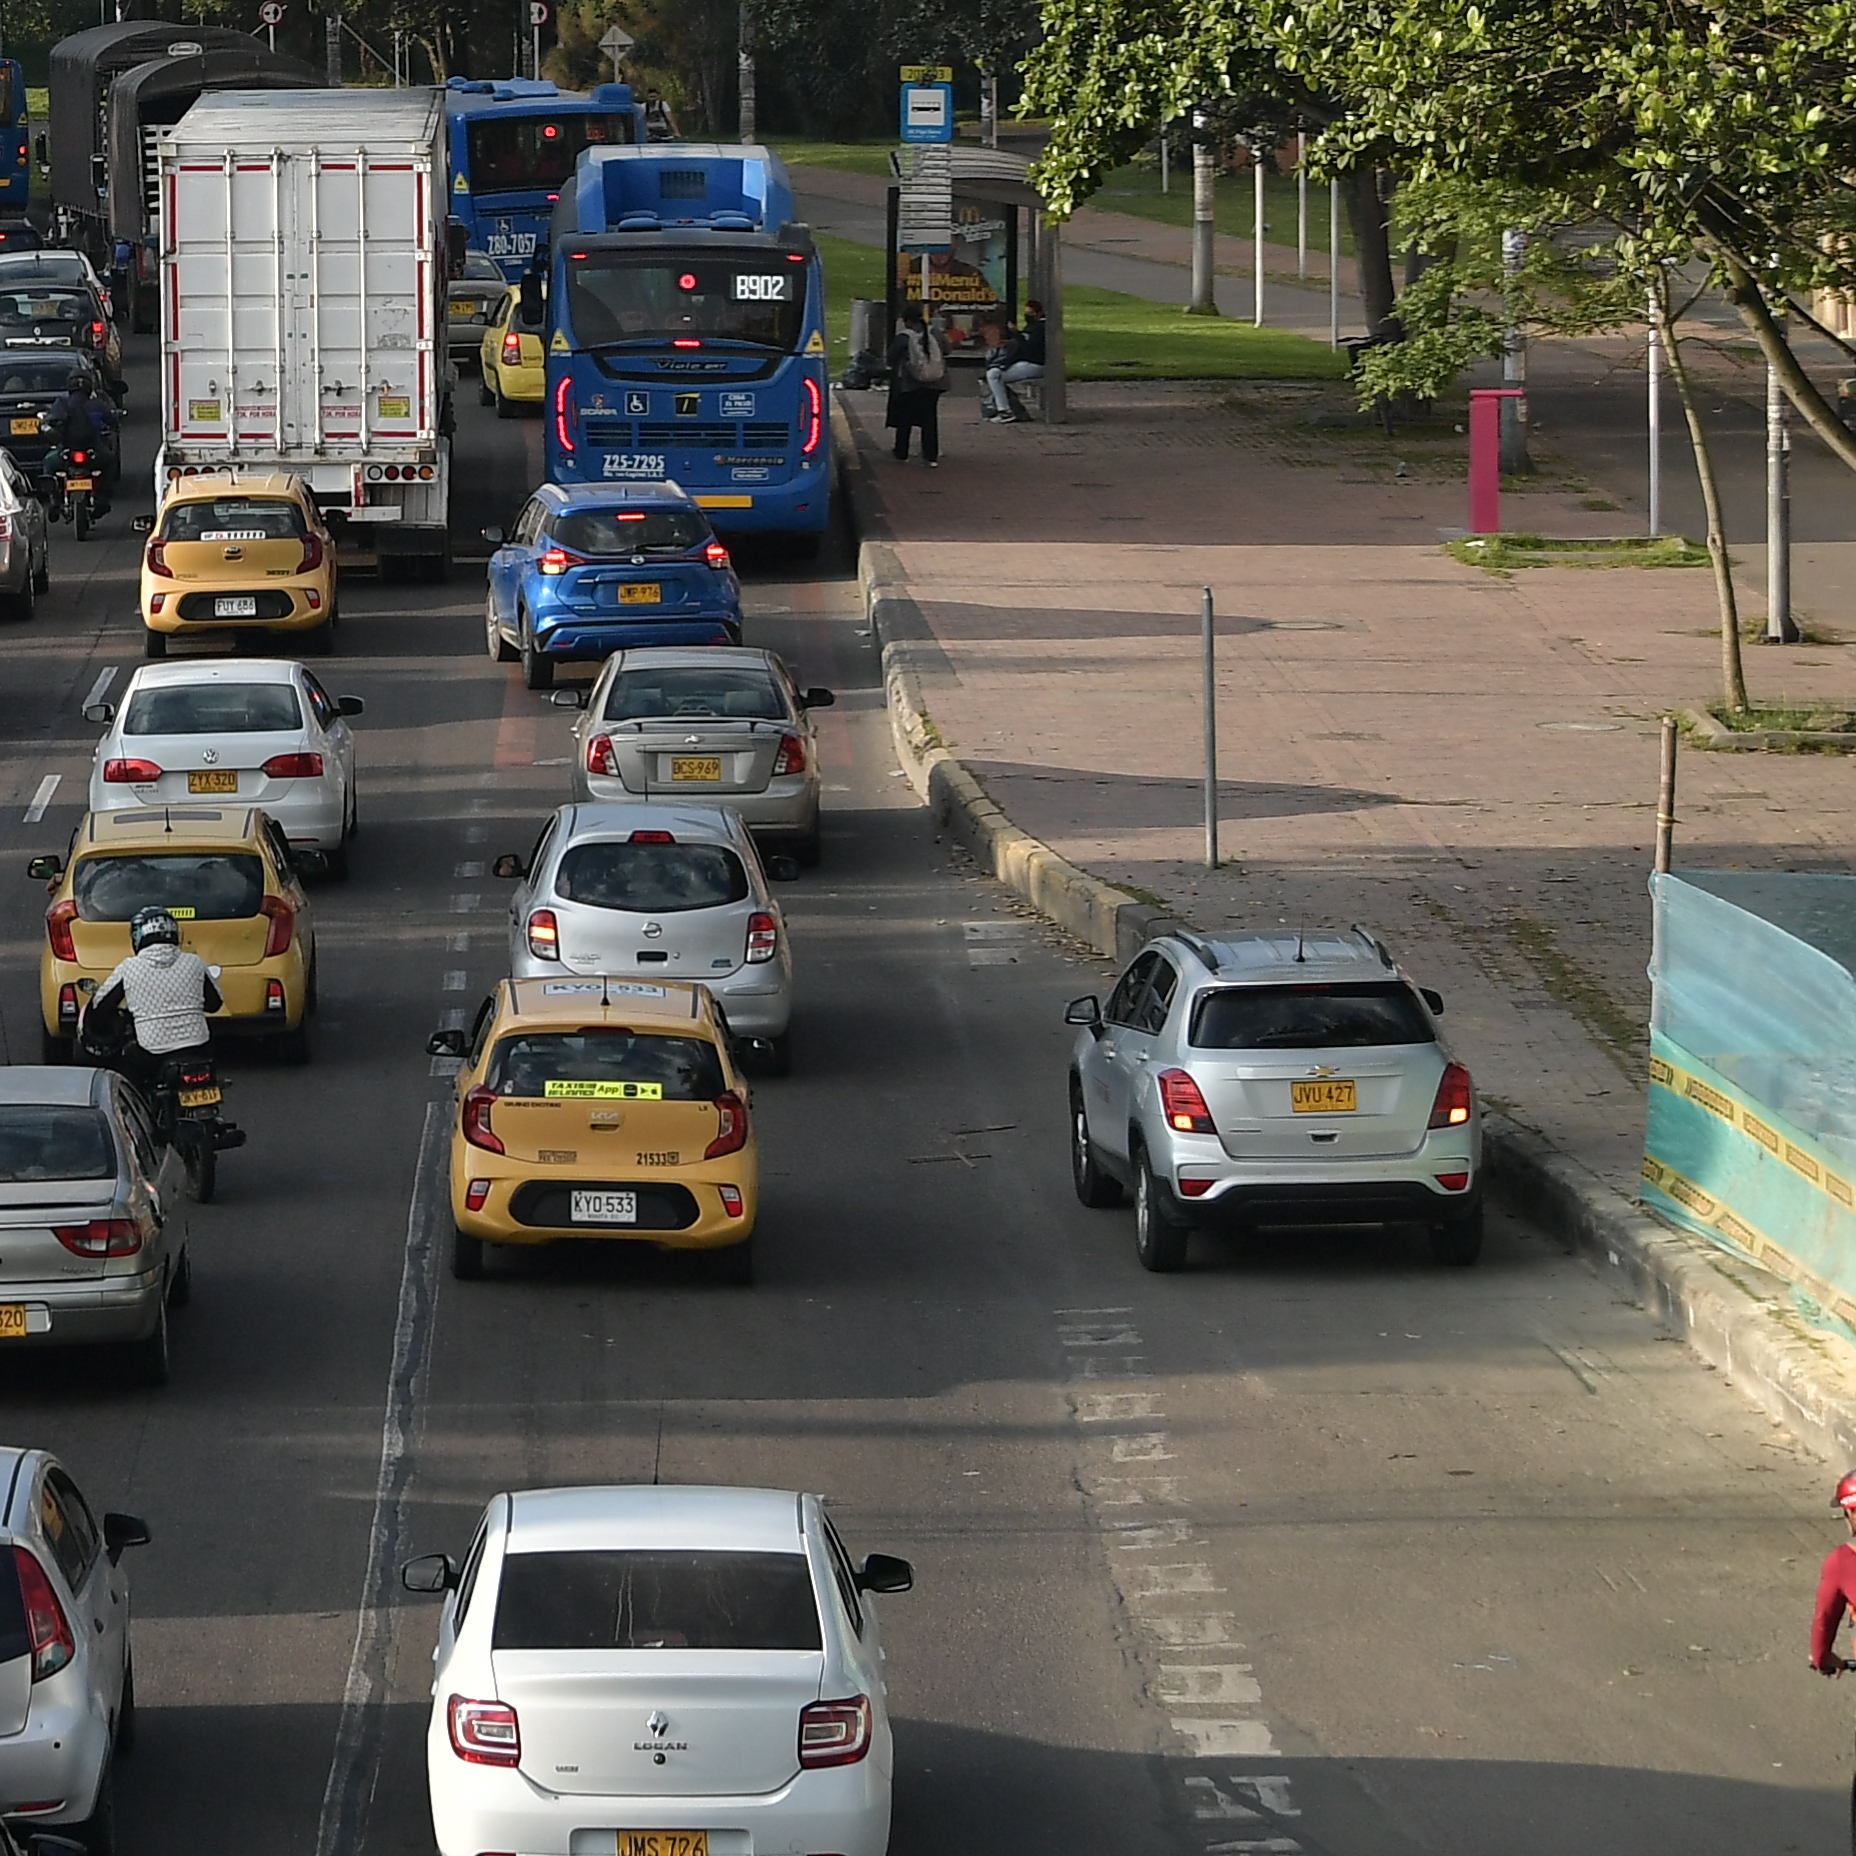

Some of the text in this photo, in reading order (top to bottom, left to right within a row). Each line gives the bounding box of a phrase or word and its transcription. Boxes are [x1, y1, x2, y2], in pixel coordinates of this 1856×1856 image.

[487, 233, 537, 255] Z80-7057
[736, 275, 784, 300] B902
[906, 288, 997, 301] MDonald's
[603, 455, 665, 469] Z25-7295
[597, 1084, 619, 1095] App
[636, 1152, 667, 1165] 21533
[633, 1742, 688, 1751] LOGAN
